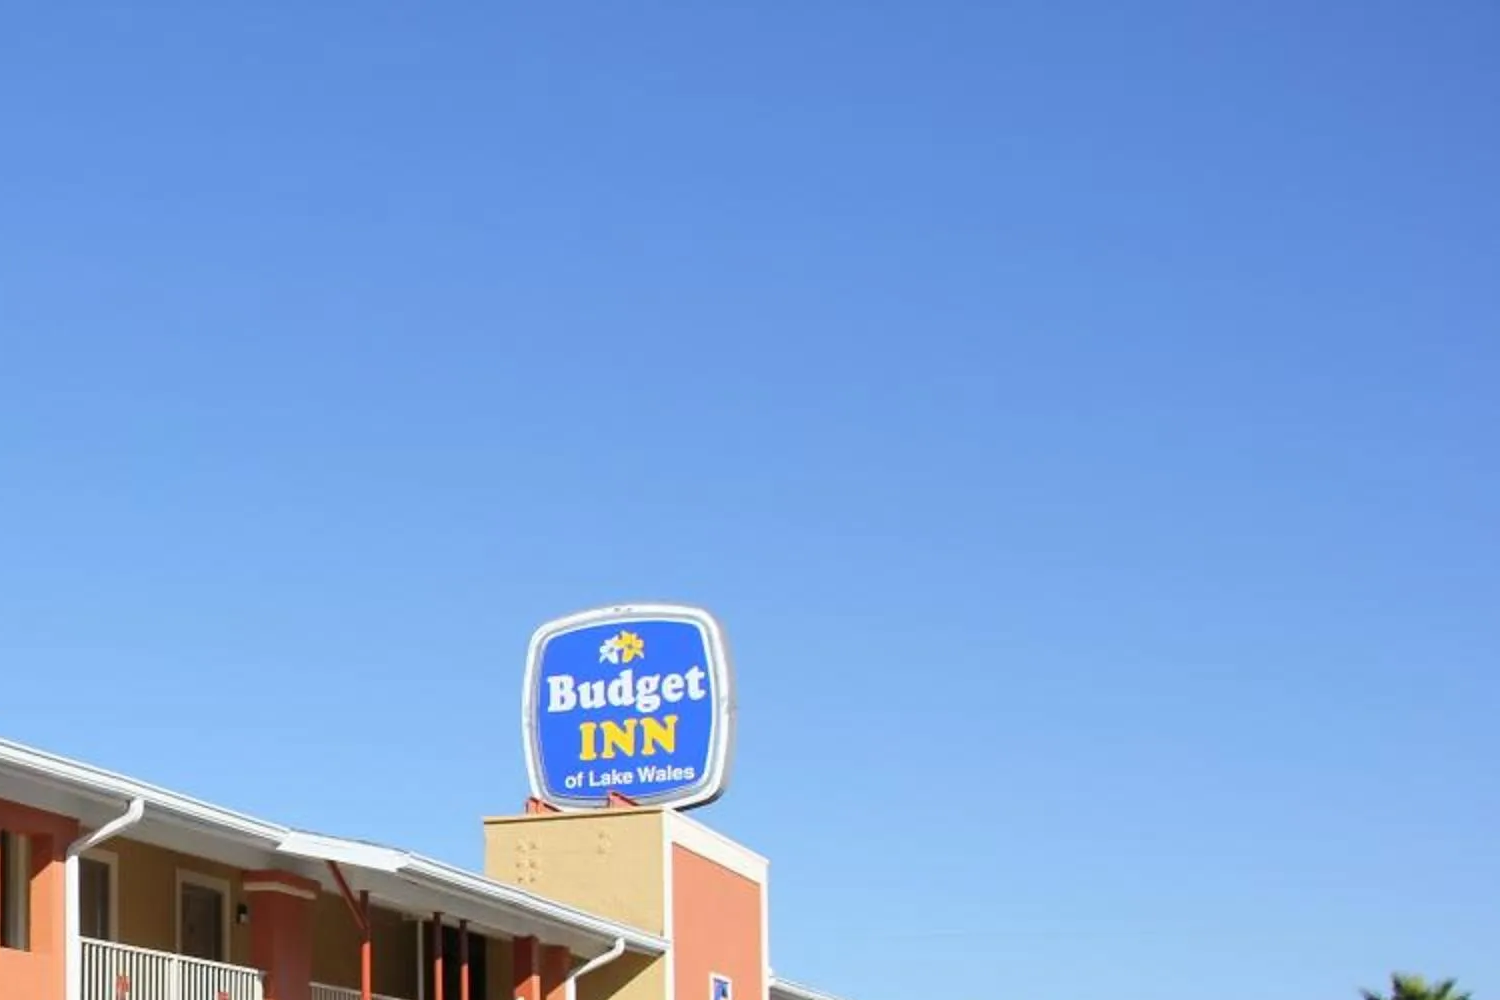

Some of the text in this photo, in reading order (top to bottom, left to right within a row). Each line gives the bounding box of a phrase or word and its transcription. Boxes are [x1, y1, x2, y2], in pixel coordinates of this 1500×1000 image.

[547, 665, 706, 713] Budget
[579, 715, 678, 760] INN
[565, 764, 695, 788] of Lake Wales
